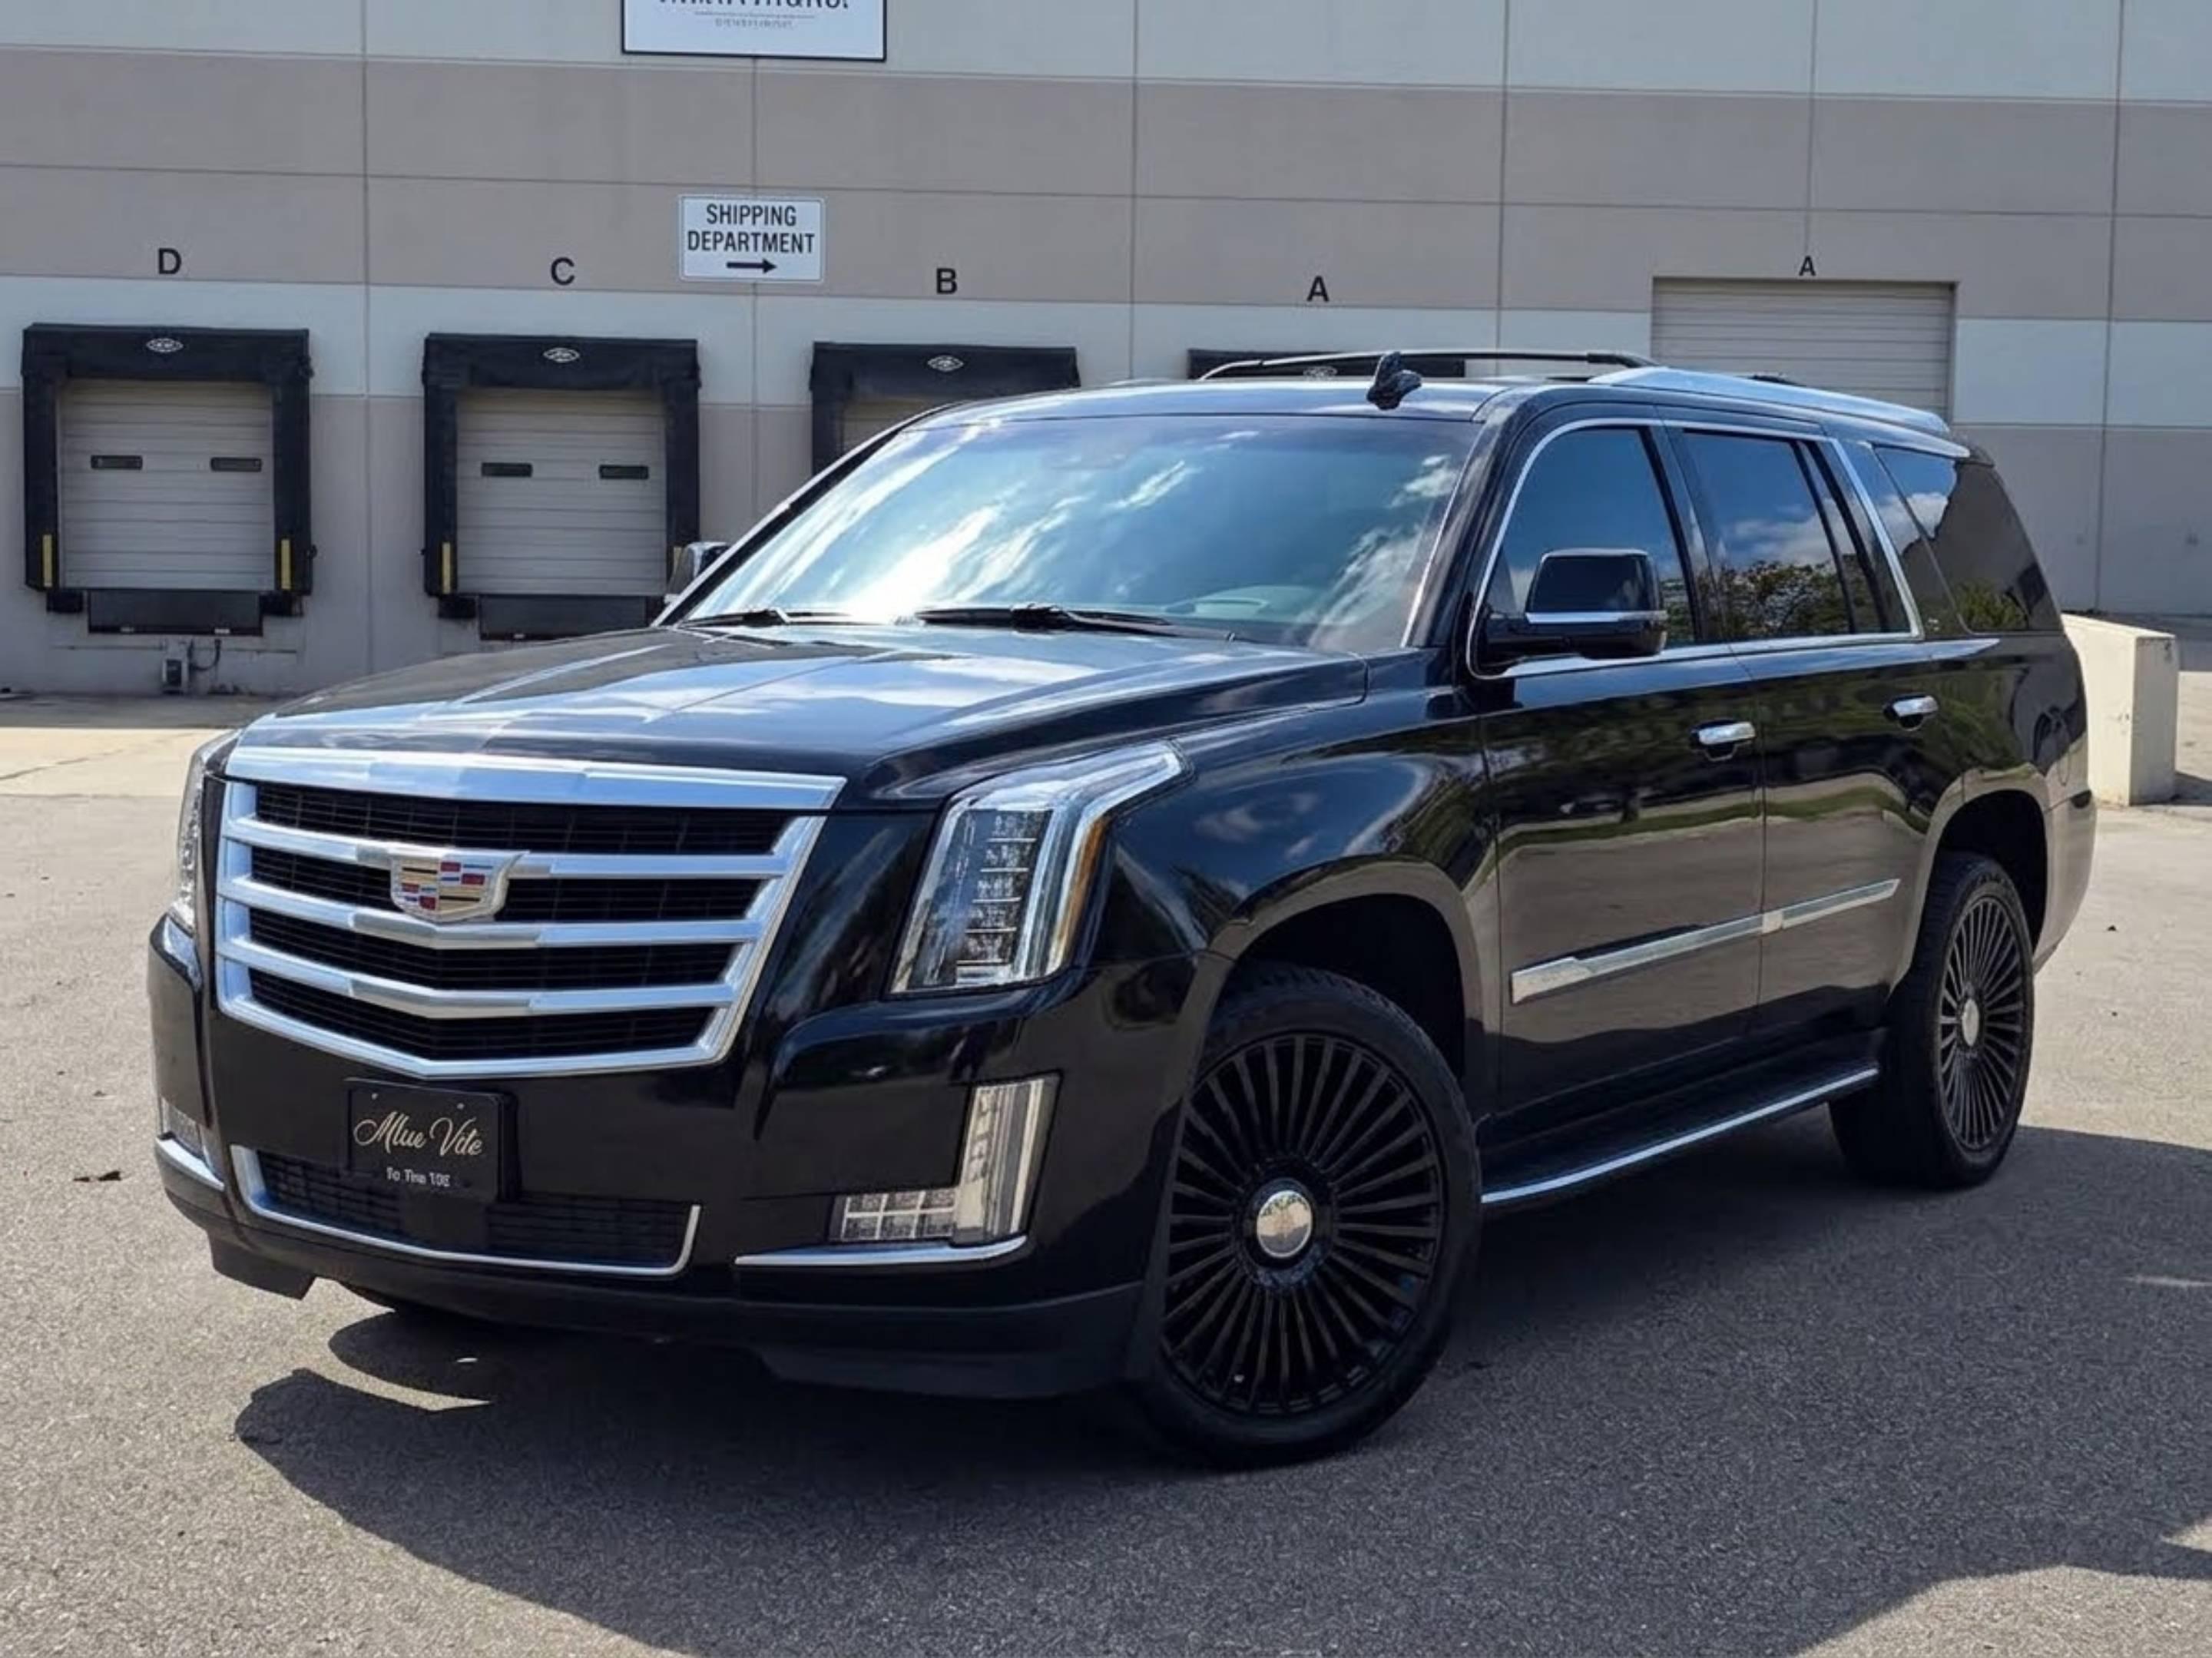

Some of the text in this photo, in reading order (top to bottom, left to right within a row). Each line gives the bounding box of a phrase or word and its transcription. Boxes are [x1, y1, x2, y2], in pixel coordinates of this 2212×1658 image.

[707, 204, 796, 227] SHIPPING
[687, 230, 815, 253] DEPARTMENT
[158, 247, 182, 275] D
[551, 257, 575, 286] C
[1799, 255, 1816, 276] A
[935, 268, 958, 295] B
[1306, 276, 1330, 303] A
